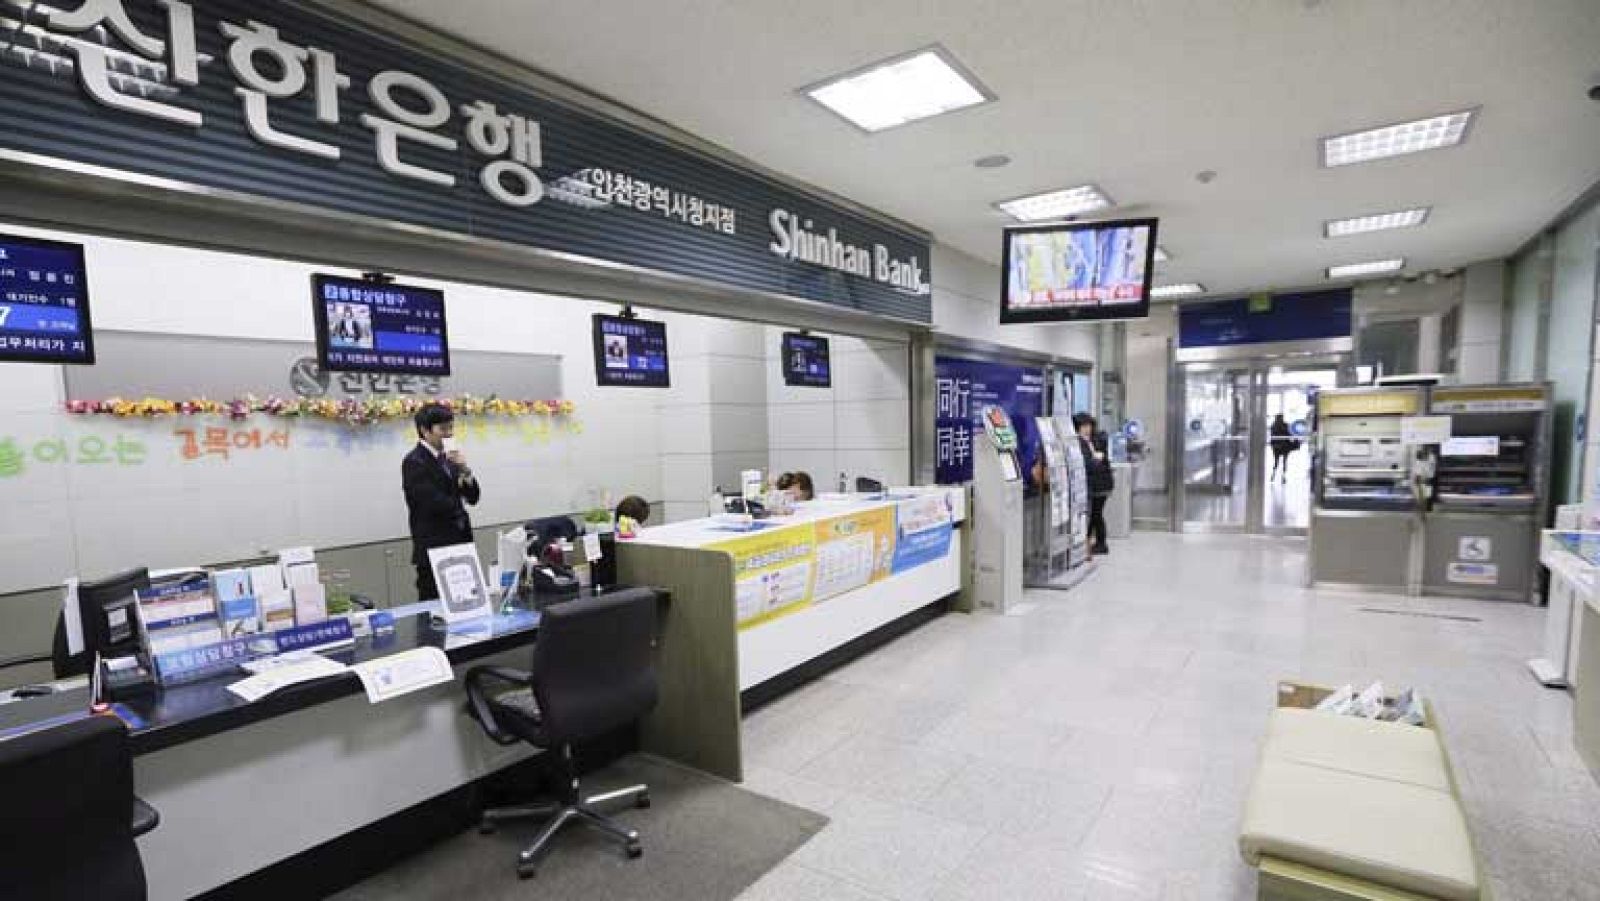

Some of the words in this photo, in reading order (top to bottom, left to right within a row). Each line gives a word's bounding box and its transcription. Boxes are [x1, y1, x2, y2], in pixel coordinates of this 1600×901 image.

[592, 168, 736, 234] 인천광역시청지점
[769, 208, 870, 278] Shinhan
[874, 243, 922, 291] Bank
